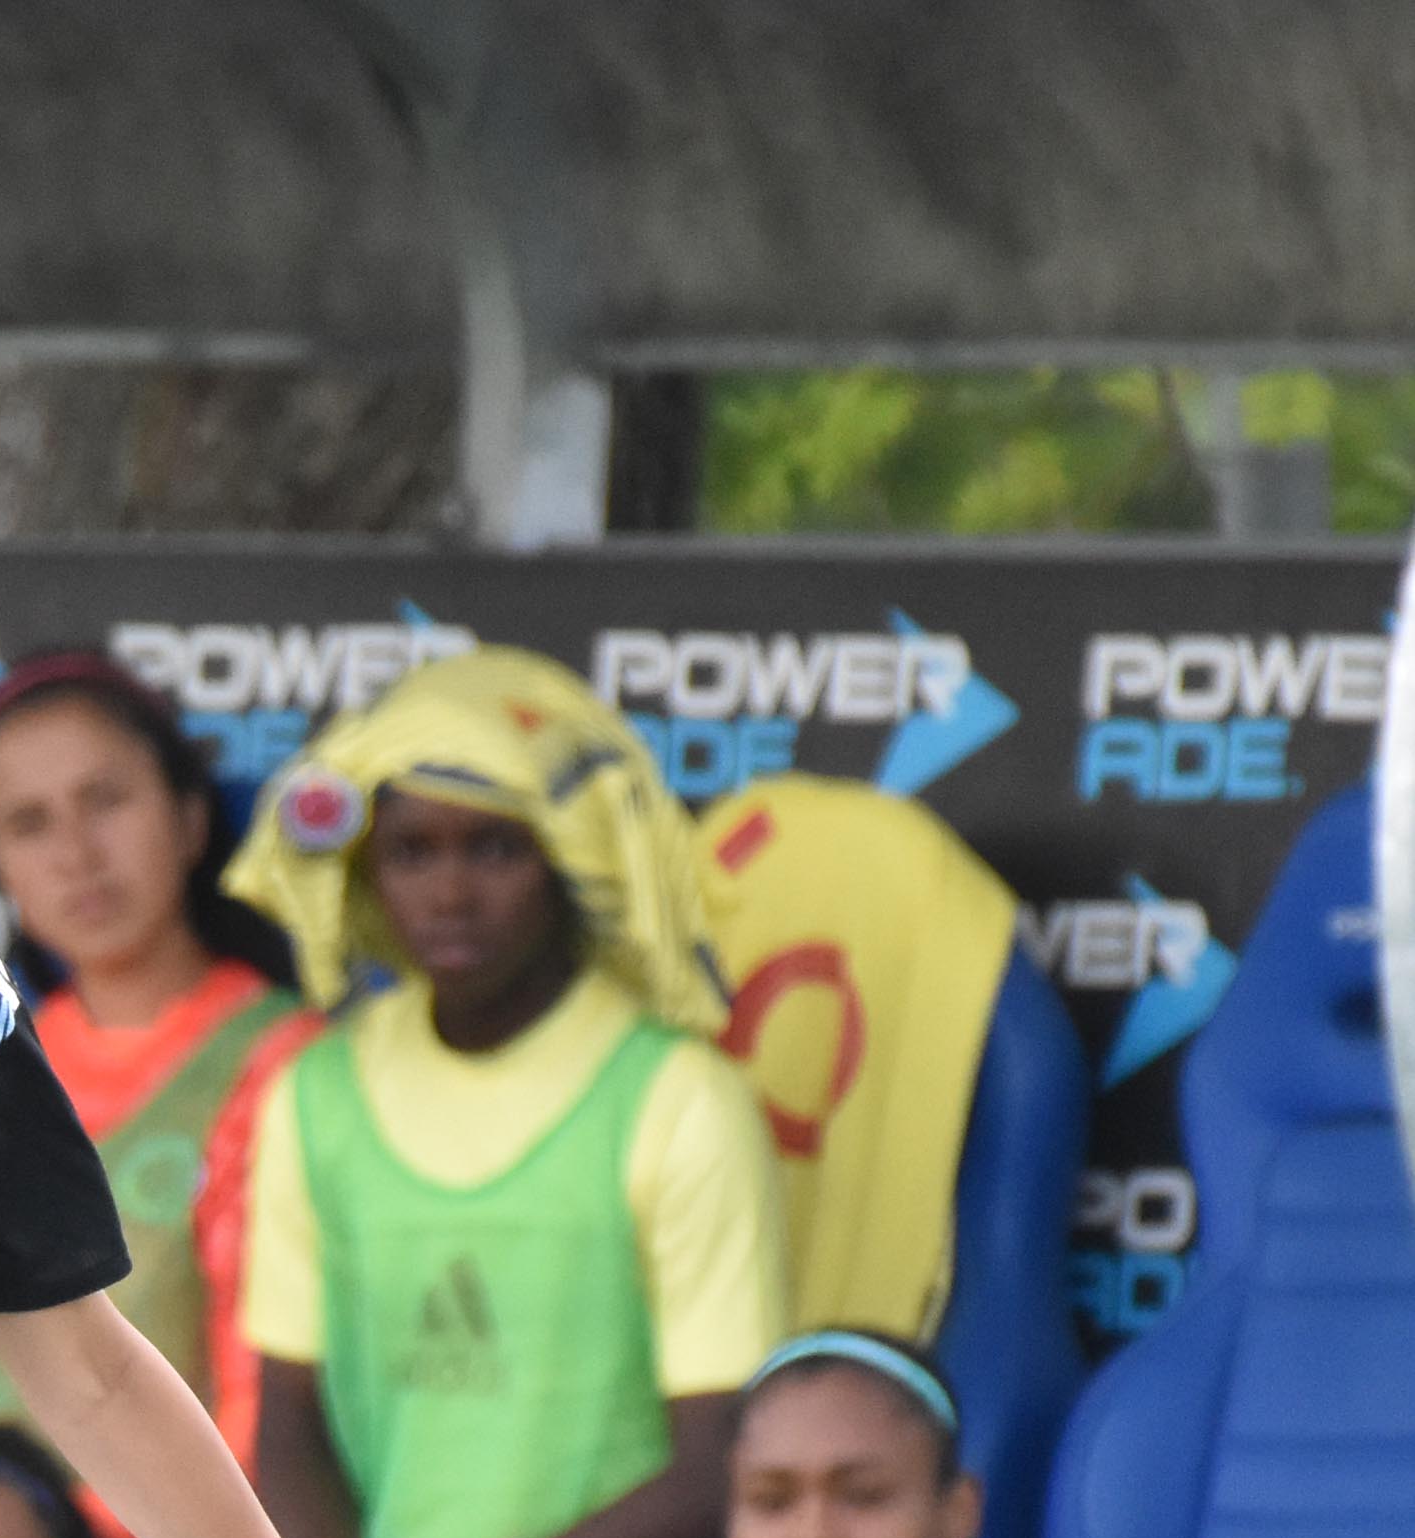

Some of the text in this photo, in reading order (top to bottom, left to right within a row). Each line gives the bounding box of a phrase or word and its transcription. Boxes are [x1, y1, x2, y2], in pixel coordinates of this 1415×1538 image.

[592, 628, 970, 722] POWER
[1081, 630, 1391, 724] POWE
[1079, 715, 1291, 802] ADE
